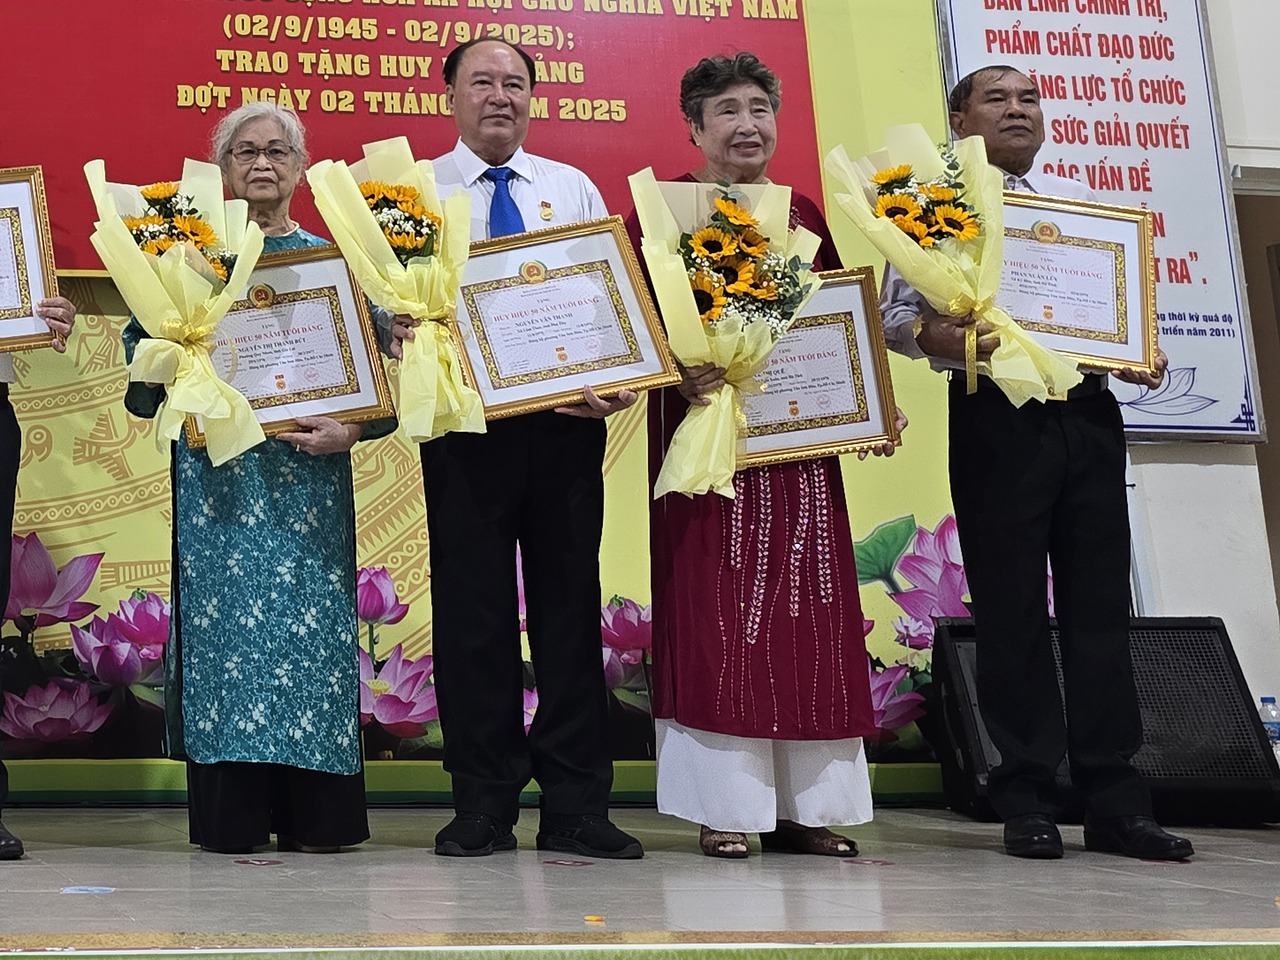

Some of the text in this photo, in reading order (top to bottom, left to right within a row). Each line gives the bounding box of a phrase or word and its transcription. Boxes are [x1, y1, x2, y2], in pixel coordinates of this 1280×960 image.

[222, 14, 378, 42] (02/9/1945
[985, 19, 1175, 64] PHẨM CHẤT ĐẠO ĐỨC
[216, 49, 585, 84] TRAO TẶNG HUY ẢNG
[176, 81, 231, 113] ĐỢT
[320, 89, 354, 112] 02
[559, 99, 627, 122] 2025
[1029, 67, 1186, 107] ĂNG LỰC TỔ CHỨC
[1051, 112, 1190, 151] SỨC GIẢI QUYẾT
[1084, 156, 1153, 193] VẤN ĐỀ
[1186, 326, 1207, 337] năm
[1209, 327, 1235, 338] 2011)
[1202, 313, 1220, 324] quá
[1221, 313, 1233, 324] độ
